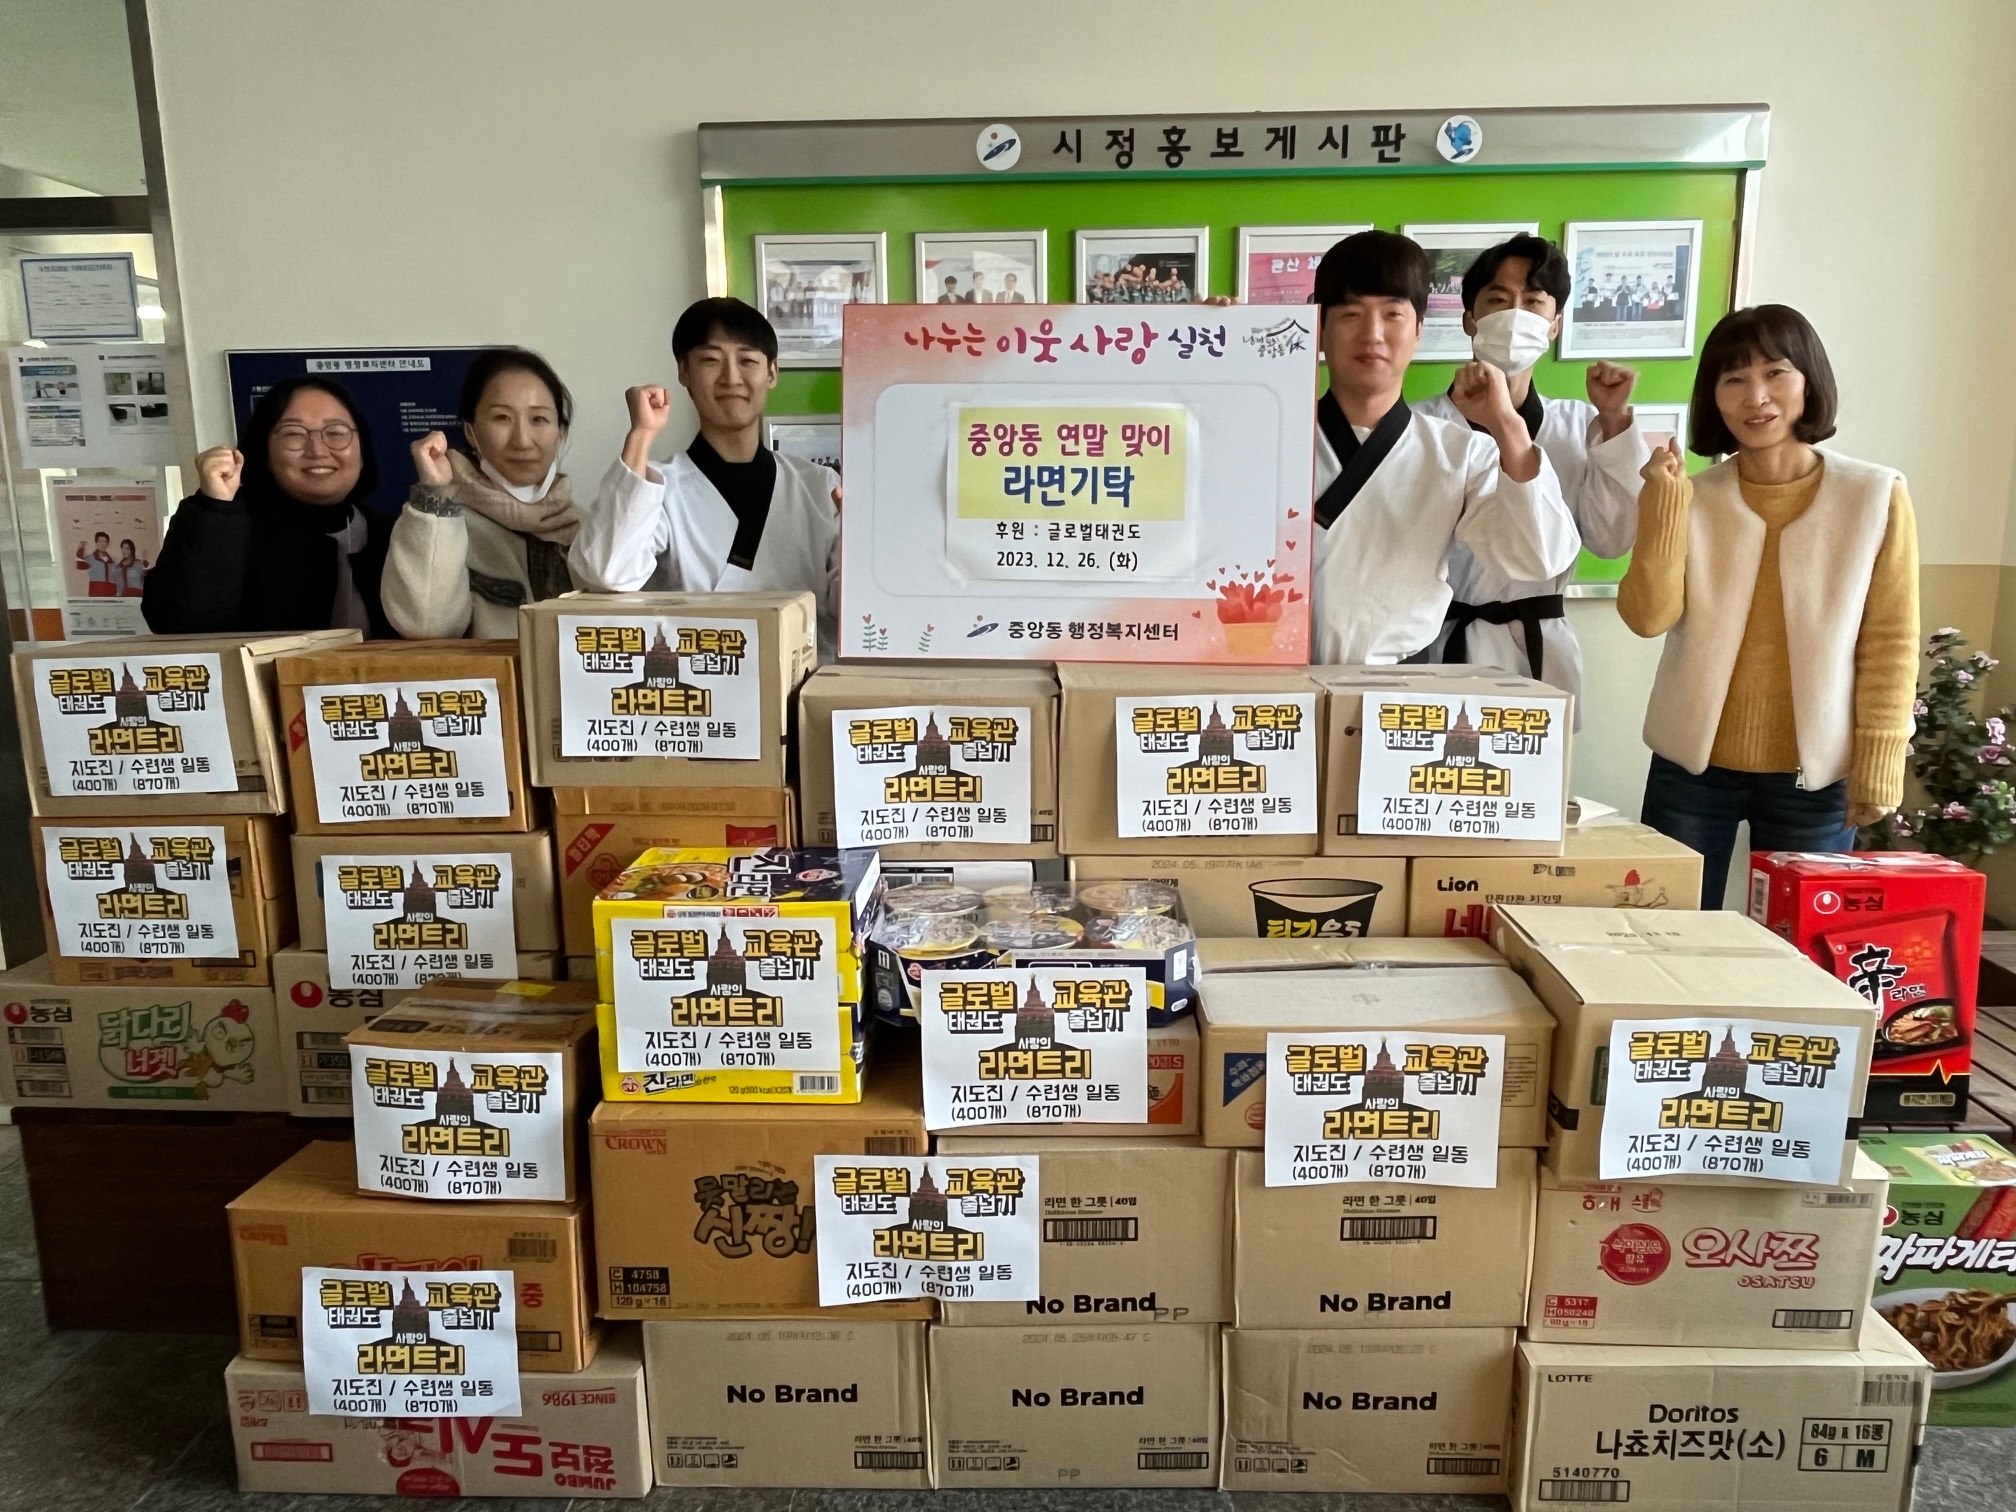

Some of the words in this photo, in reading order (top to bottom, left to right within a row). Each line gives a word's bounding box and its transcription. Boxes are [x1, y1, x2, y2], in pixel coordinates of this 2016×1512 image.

[904, 322, 986, 356] 나누는
[996, 318, 1062, 363] 이웃
[1069, 321, 1158, 365] 사랑
[1167, 325, 1226, 360] 실천
[967, 423, 1043, 457] 중앙동
[1057, 423, 1107, 458] 연말
[1121, 422, 1171, 457] 맞이
[1003, 465, 1135, 508] 라면기탁
[995, 521, 1025, 540] 후원
[1048, 521, 1142, 541] 글로벌태권도
[996, 551, 1038, 569] 2023.
[1046, 551, 1069, 568] 12.
[1077, 551, 1100, 569] 26.
[1109, 550, 1139, 571] (화)
[575, 626, 646, 656] 글로벌
[677, 628, 747, 658] 교육관
[1007, 621, 1064, 640] 중앙동
[1068, 621, 1179, 641] 행정복지센터
[49, 668, 116, 696] 글로벌
[143, 665, 210, 696] 교육관
[320, 694, 389, 722] 글로벌
[417, 690, 487, 719] 교육관
[611, 688, 712, 717] 라면트리
[849, 718, 917, 745] 글로벌
[949, 717, 1018, 744] 교육관
[1132, 706, 1201, 736] 글로벌
[1232, 704, 1303, 734] 교육관
[1379, 703, 1449, 734] 글로벌
[1478, 707, 1551, 738] 교육관
[88, 726, 184, 756] 라면트리
[359, 751, 458, 781] 라면트리
[72, 778, 118, 792] (400개)
[132, 777, 180, 790] (870개)
[885, 776, 982, 803] 라면트리
[1167, 765, 1267, 795] 라면트리
[1409, 765, 1510, 797] 라면트리
[59, 837, 123, 864] 글로벌
[149, 837, 215, 863] 교육관
[338, 865, 405, 892] 글로벌
[433, 864, 501, 891] 교육관
[1437, 878, 1479, 892] Lion
[96, 893, 189, 920] 라면트리
[1843, 893, 1884, 912] 농심
[373, 923, 468, 950] 라면트리
[630, 930, 708, 960] 글로벌
[743, 930, 823, 960] 교육관
[639, 959, 695, 980] 태권도
[760, 957, 815, 980] 줄넘기
[710, 984, 742, 995] 사랑의
[940, 981, 1017, 1013] 글로벌
[1052, 980, 1132, 1012] 교육관
[1891, 983, 1926, 1001] 라면
[30, 1005, 73, 1023] 농심
[98, 1001, 192, 1050] 닭다리
[671, 997, 783, 1027] 라면트리
[644, 1032, 696, 1050] 지도진
[718, 1032, 770, 1048] 수련생
[778, 1032, 812, 1050] 일동
[1629, 1031, 1711, 1062] 글로벌
[1748, 1033, 1840, 1068] 교육관
[646, 1052, 702, 1066] (400개)
[720, 1052, 776, 1066] (870개)
[979, 1049, 1091, 1080] 라면트리
[1286, 1044, 1367, 1076] 글로벌
[1403, 1044, 1489, 1076] 교육관
[365, 1058, 438, 1091] 글로벌
[471, 1064, 549, 1094] 교육관
[643, 1072, 695, 1095] 진라면
[951, 1105, 1007, 1121] (400개)
[1027, 1105, 1082, 1118] (870개)
[1323, 1110, 1440, 1140] 라면트리
[1659, 1099, 1783, 1132] 라면트리
[402, 1124, 510, 1157] 라면트리
[605, 1136, 667, 1150] CROWN
[1293, 1145, 1346, 1162] 지도진
[1369, 1144, 1424, 1162] 수련생
[1433, 1145, 1468, 1164] 일동
[380, 1177, 429, 1193] (400개)
[447, 1181, 502, 1194] (870개)
[833, 1167, 911, 1198] 글로벌
[945, 1168, 1025, 1198] 교육관
[1070, 1197, 1083, 1208] 한
[1085, 1197, 1108, 1208] 그릇
[1342, 1196, 1365, 1207] 라면
[1369, 1195, 1381, 1206] 한
[1384, 1196, 1408, 1206] 그릇
[1900, 1209, 1944, 1226] 농심
[873, 1229, 984, 1261] 라면트리
[1682, 1227, 1820, 1270] 오사쯔
[320, 1279, 393, 1310] 글로벌
[426, 1282, 501, 1311] 교육관
[1738, 1275, 1815, 1289] OSATSU
[1026, 1296, 1064, 1315] No
[1074, 1292, 1156, 1313] Brand
[1320, 1294, 1358, 1312] No
[1367, 1291, 1451, 1312] Brand
[358, 1344, 465, 1375] 라면트리
[1547, 1374, 1593, 1383] LOTTE
[727, 1385, 765, 1403] No
[774, 1384, 858, 1403] Brand
[1012, 1389, 1051, 1407] No
[1060, 1386, 1144, 1407] Brand
[1303, 1392, 1342, 1410] No
[1352, 1392, 1437, 1410] Brand
[1649, 1404, 1739, 1424] Doritos
[549, 1442, 614, 1475] 점보
[1595, 1429, 1786, 1461] 나쵸치즈맛(소)
[1814, 1447, 1829, 1467] 6
[1856, 1449, 1875, 1468] M
[554, 1474, 617, 1491] JUMBO
[1552, 1467, 1620, 1479] 5140770
